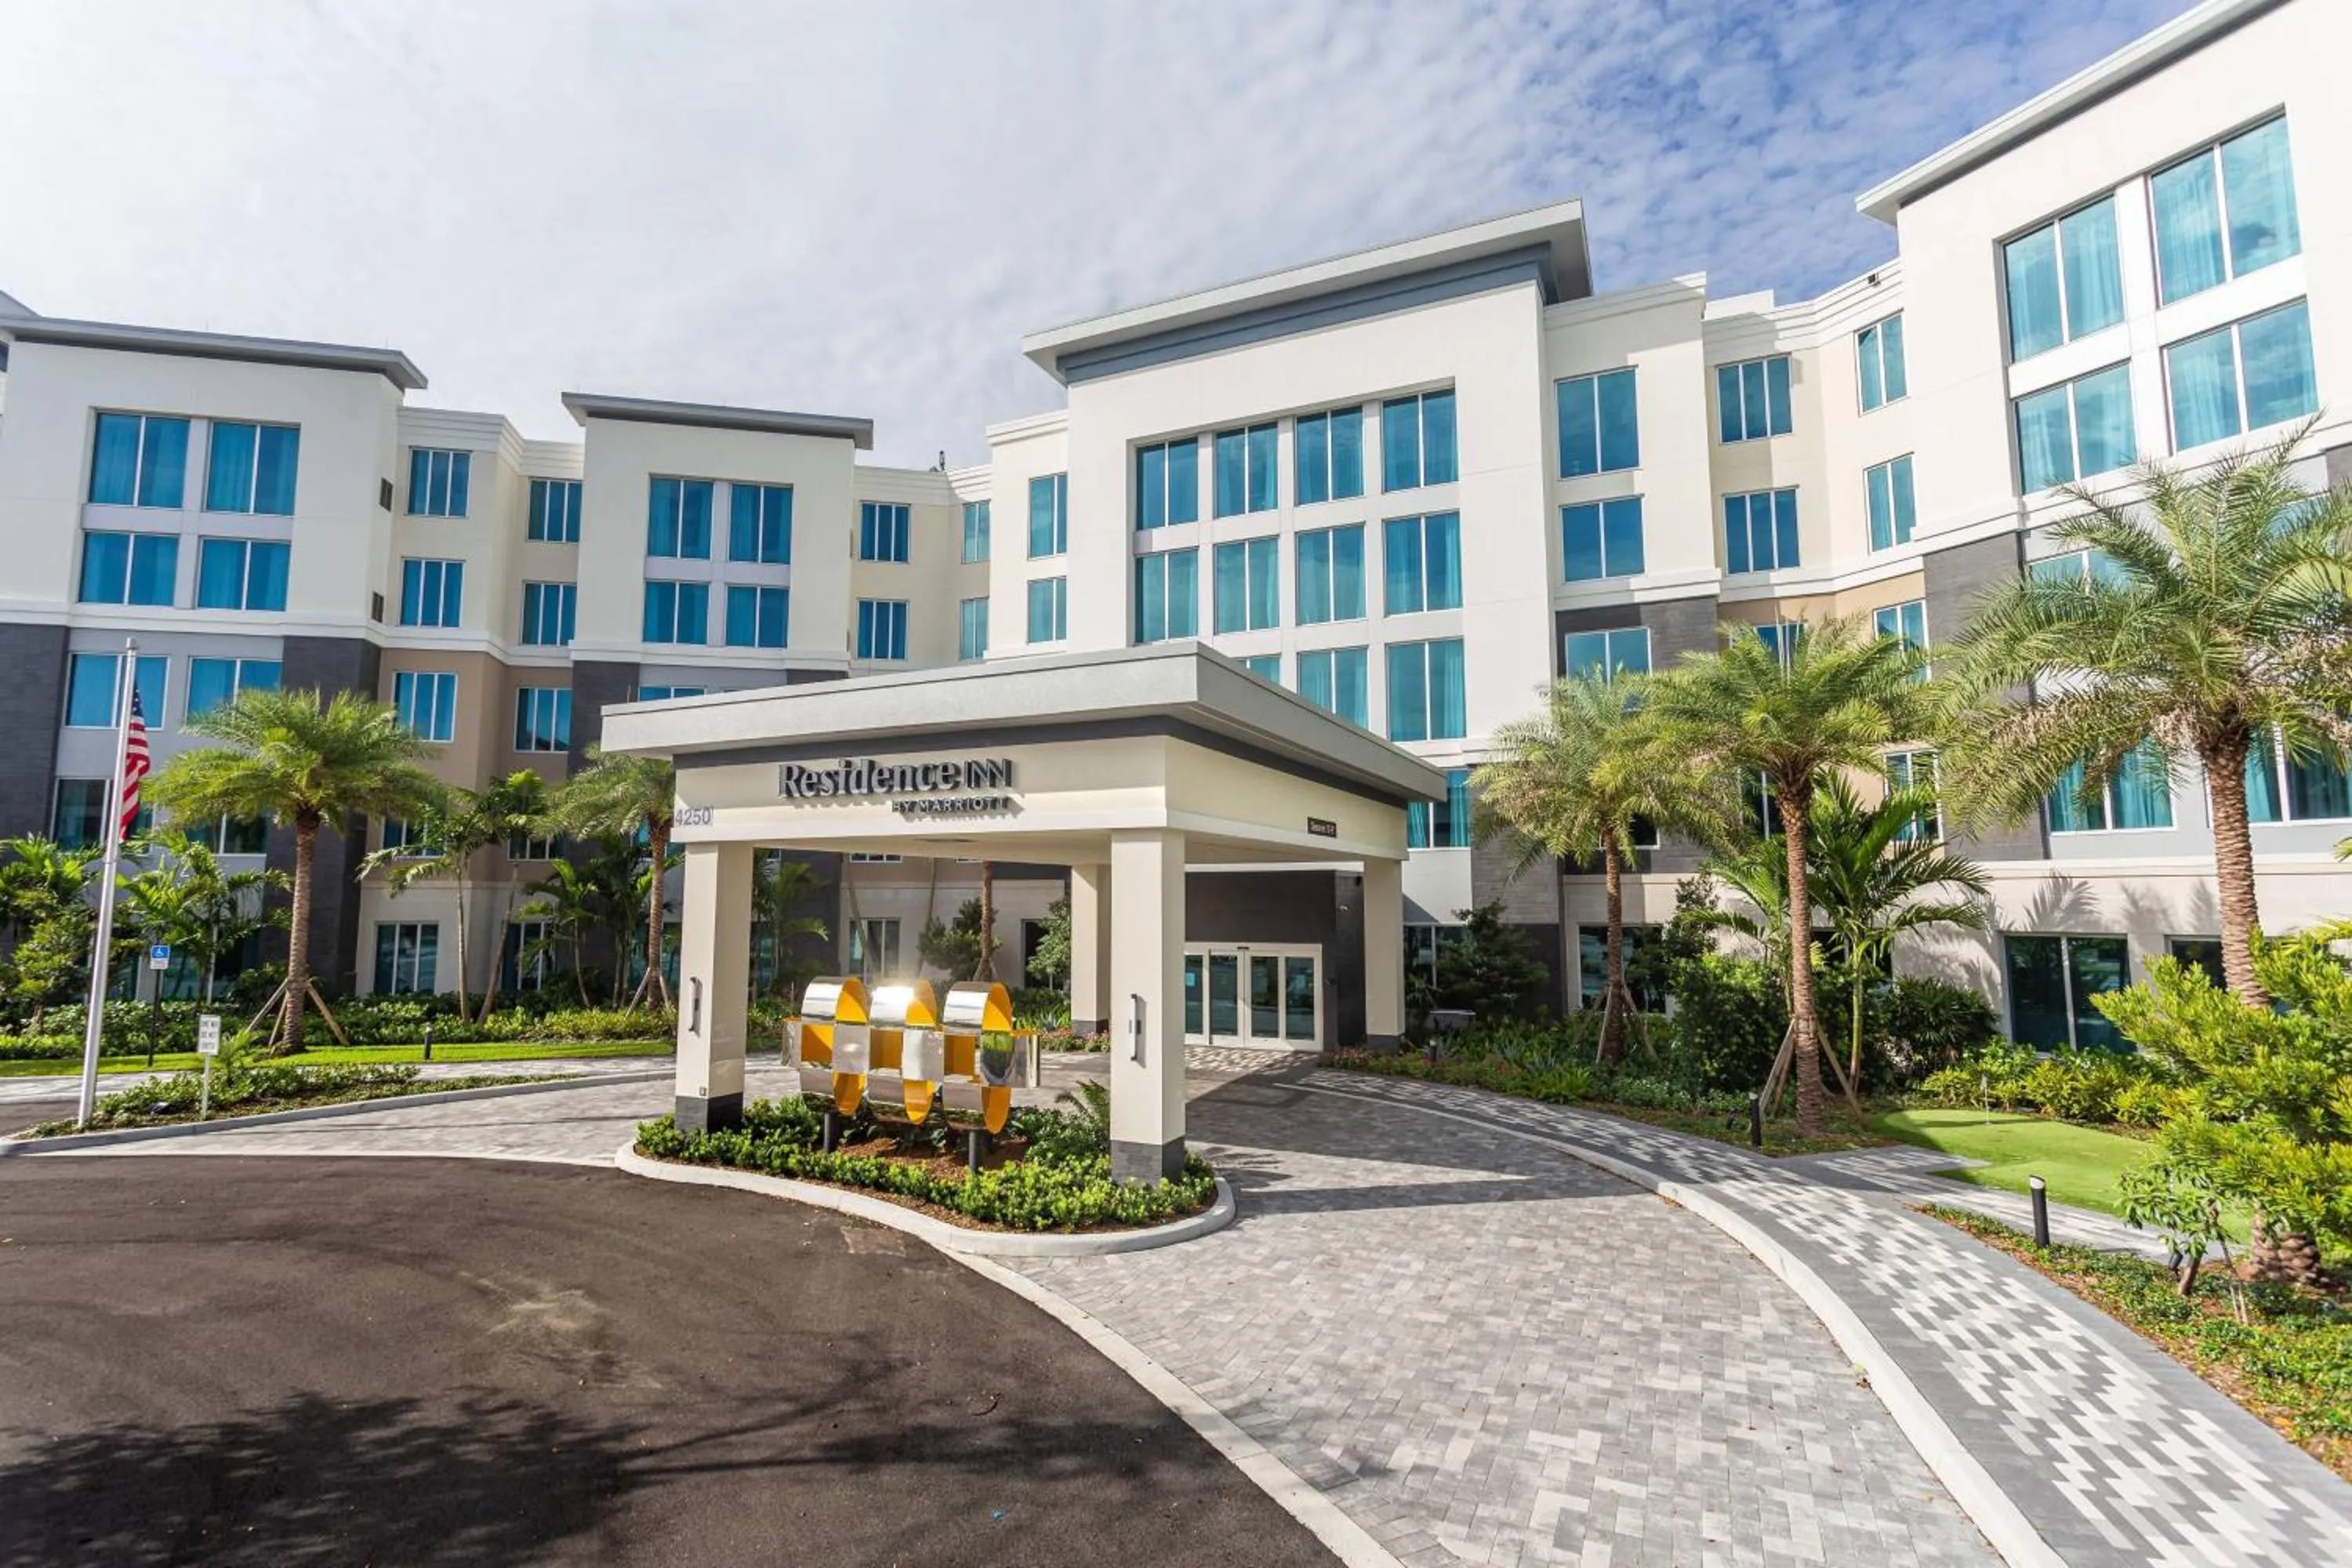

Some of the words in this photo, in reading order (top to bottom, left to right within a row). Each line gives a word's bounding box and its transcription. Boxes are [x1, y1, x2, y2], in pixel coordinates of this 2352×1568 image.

[778, 757, 960, 797] Residence
[892, 800, 912, 812] BY
[676, 808, 711, 825] 4250
